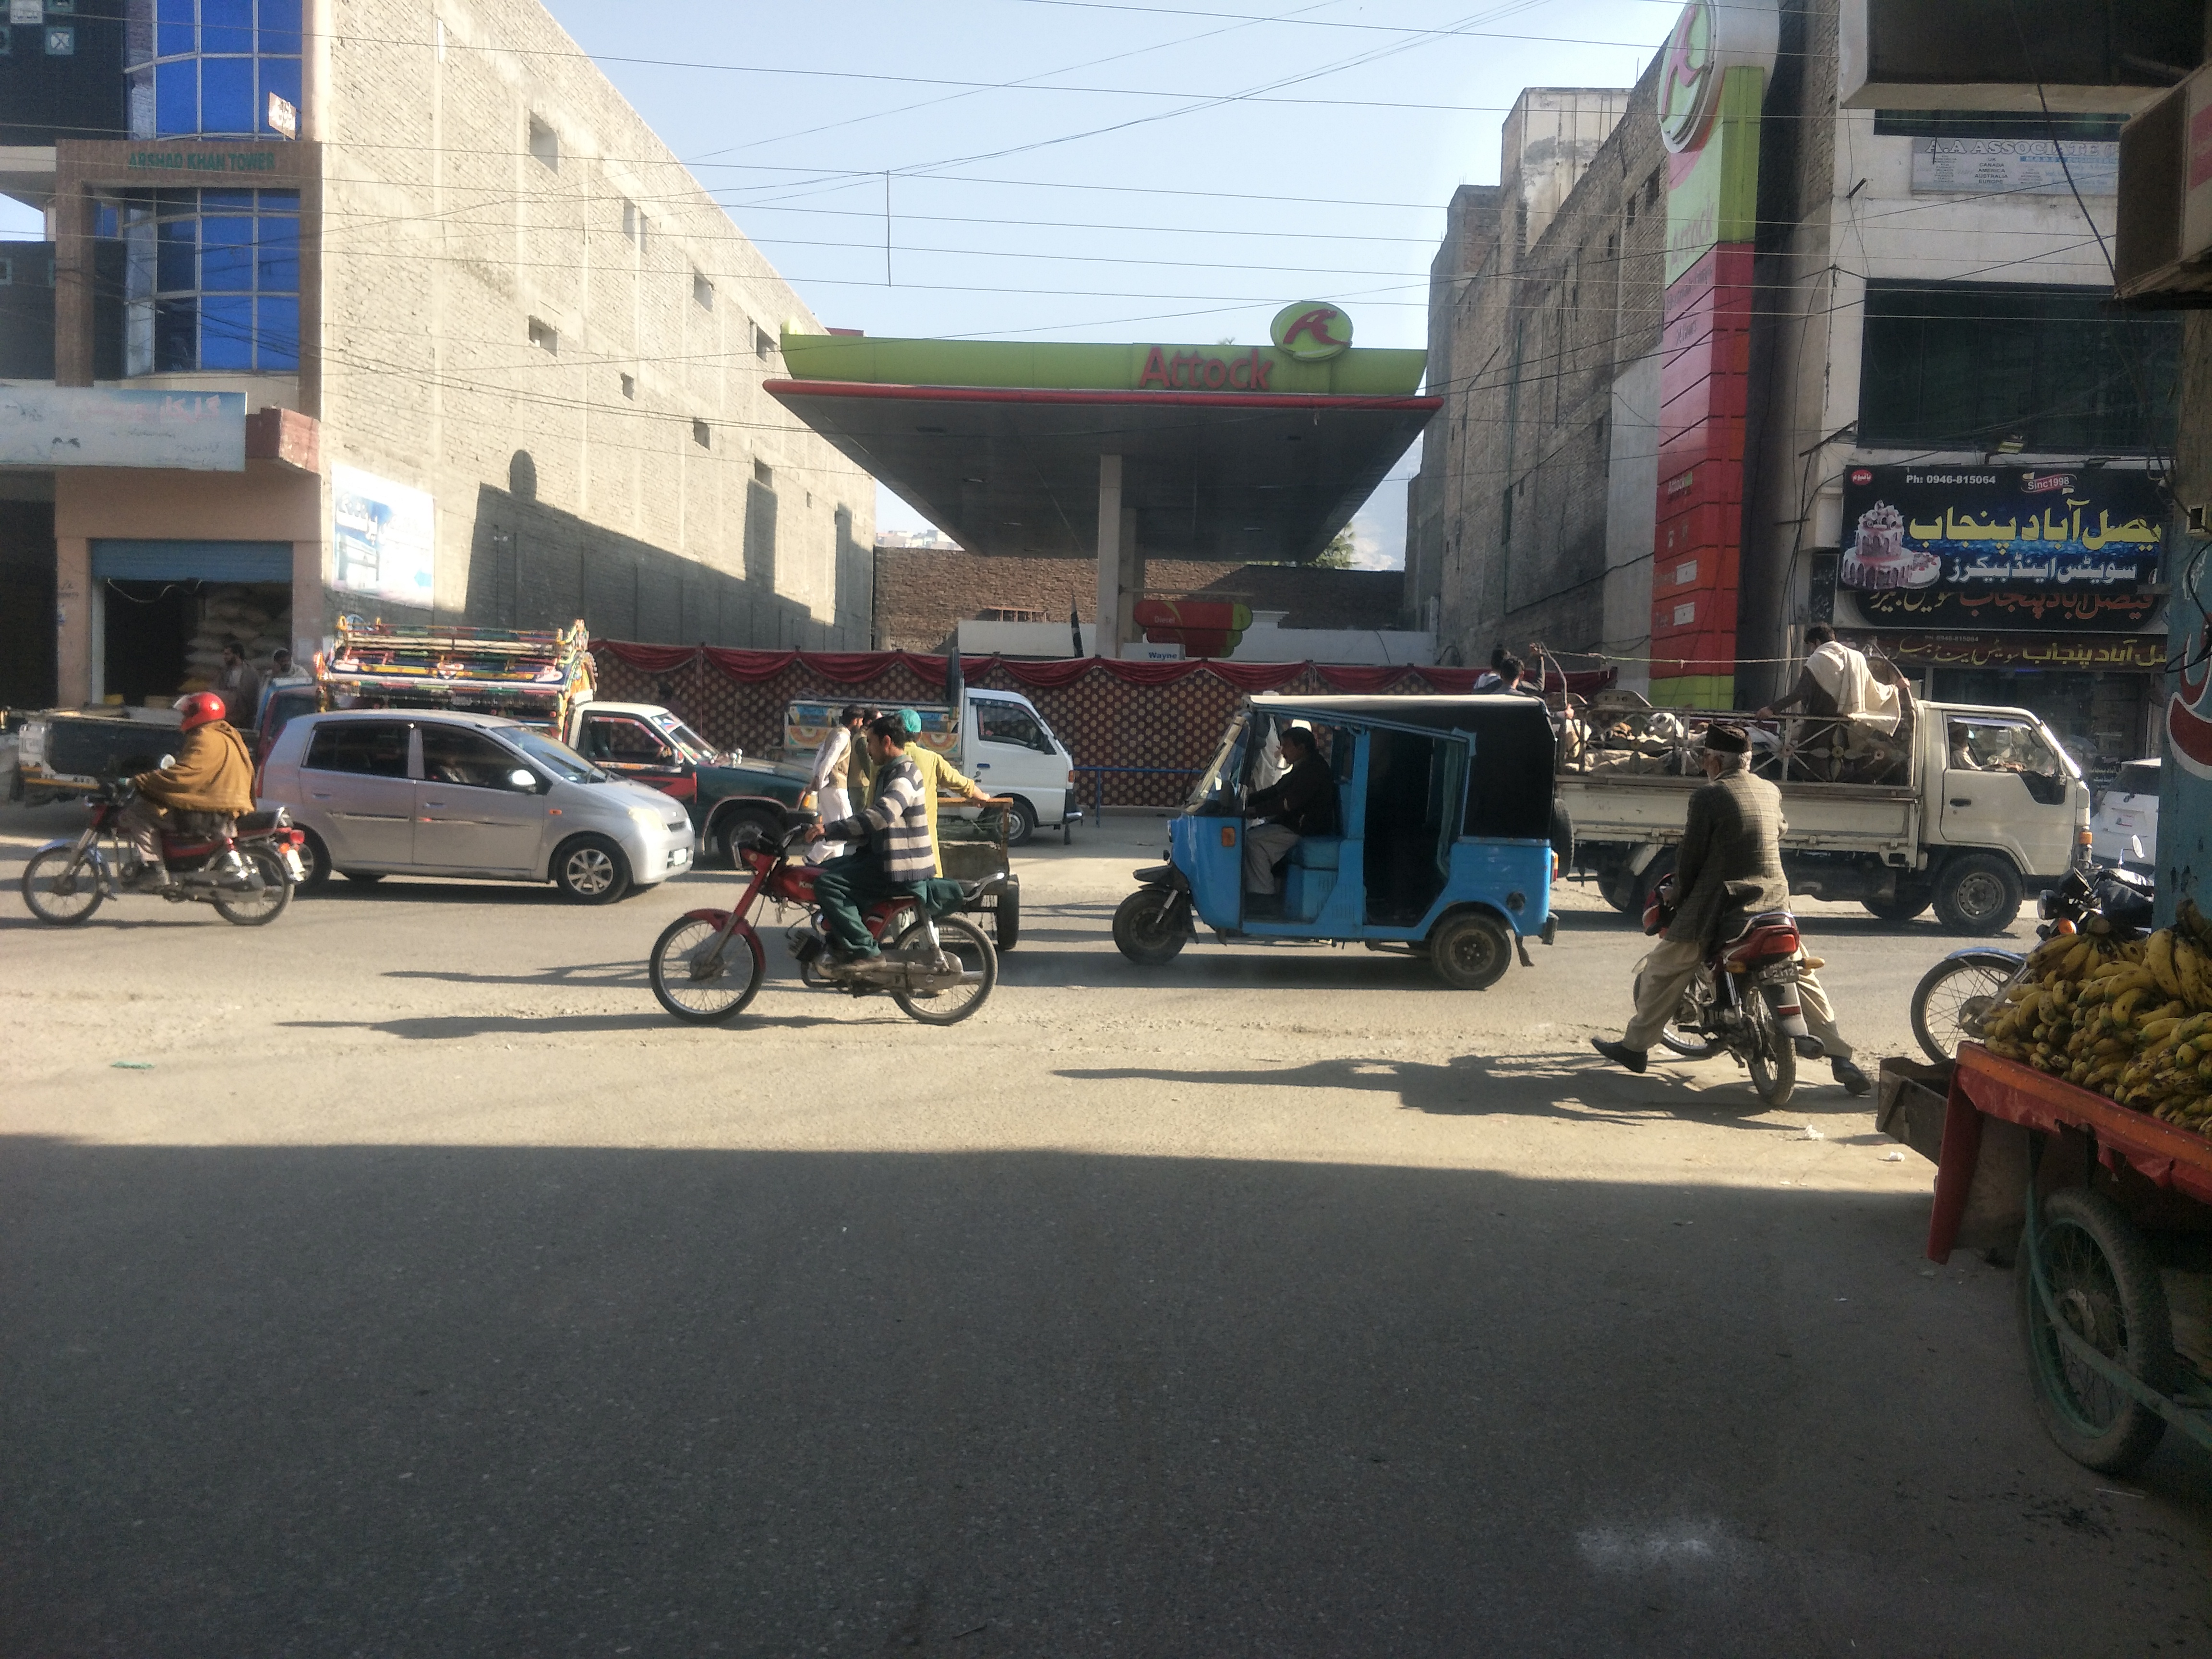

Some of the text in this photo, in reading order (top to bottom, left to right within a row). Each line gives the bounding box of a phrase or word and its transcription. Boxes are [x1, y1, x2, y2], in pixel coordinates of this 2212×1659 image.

[1971, 140, 2100, 156] ASSOCIATE
[129, 152, 275, 171] ARSHAD KHAN TOWER
[1139, 346, 1274, 390] Attock
[1906, 475, 1996, 484] Ph: 0946-815064
[1909, 505, 2017, 555] پنجاب
[2082, 508, 2162, 552] یصل
[1154, 615, 1175, 624] Diesel
[1148, 651, 1178, 661] Wayne
